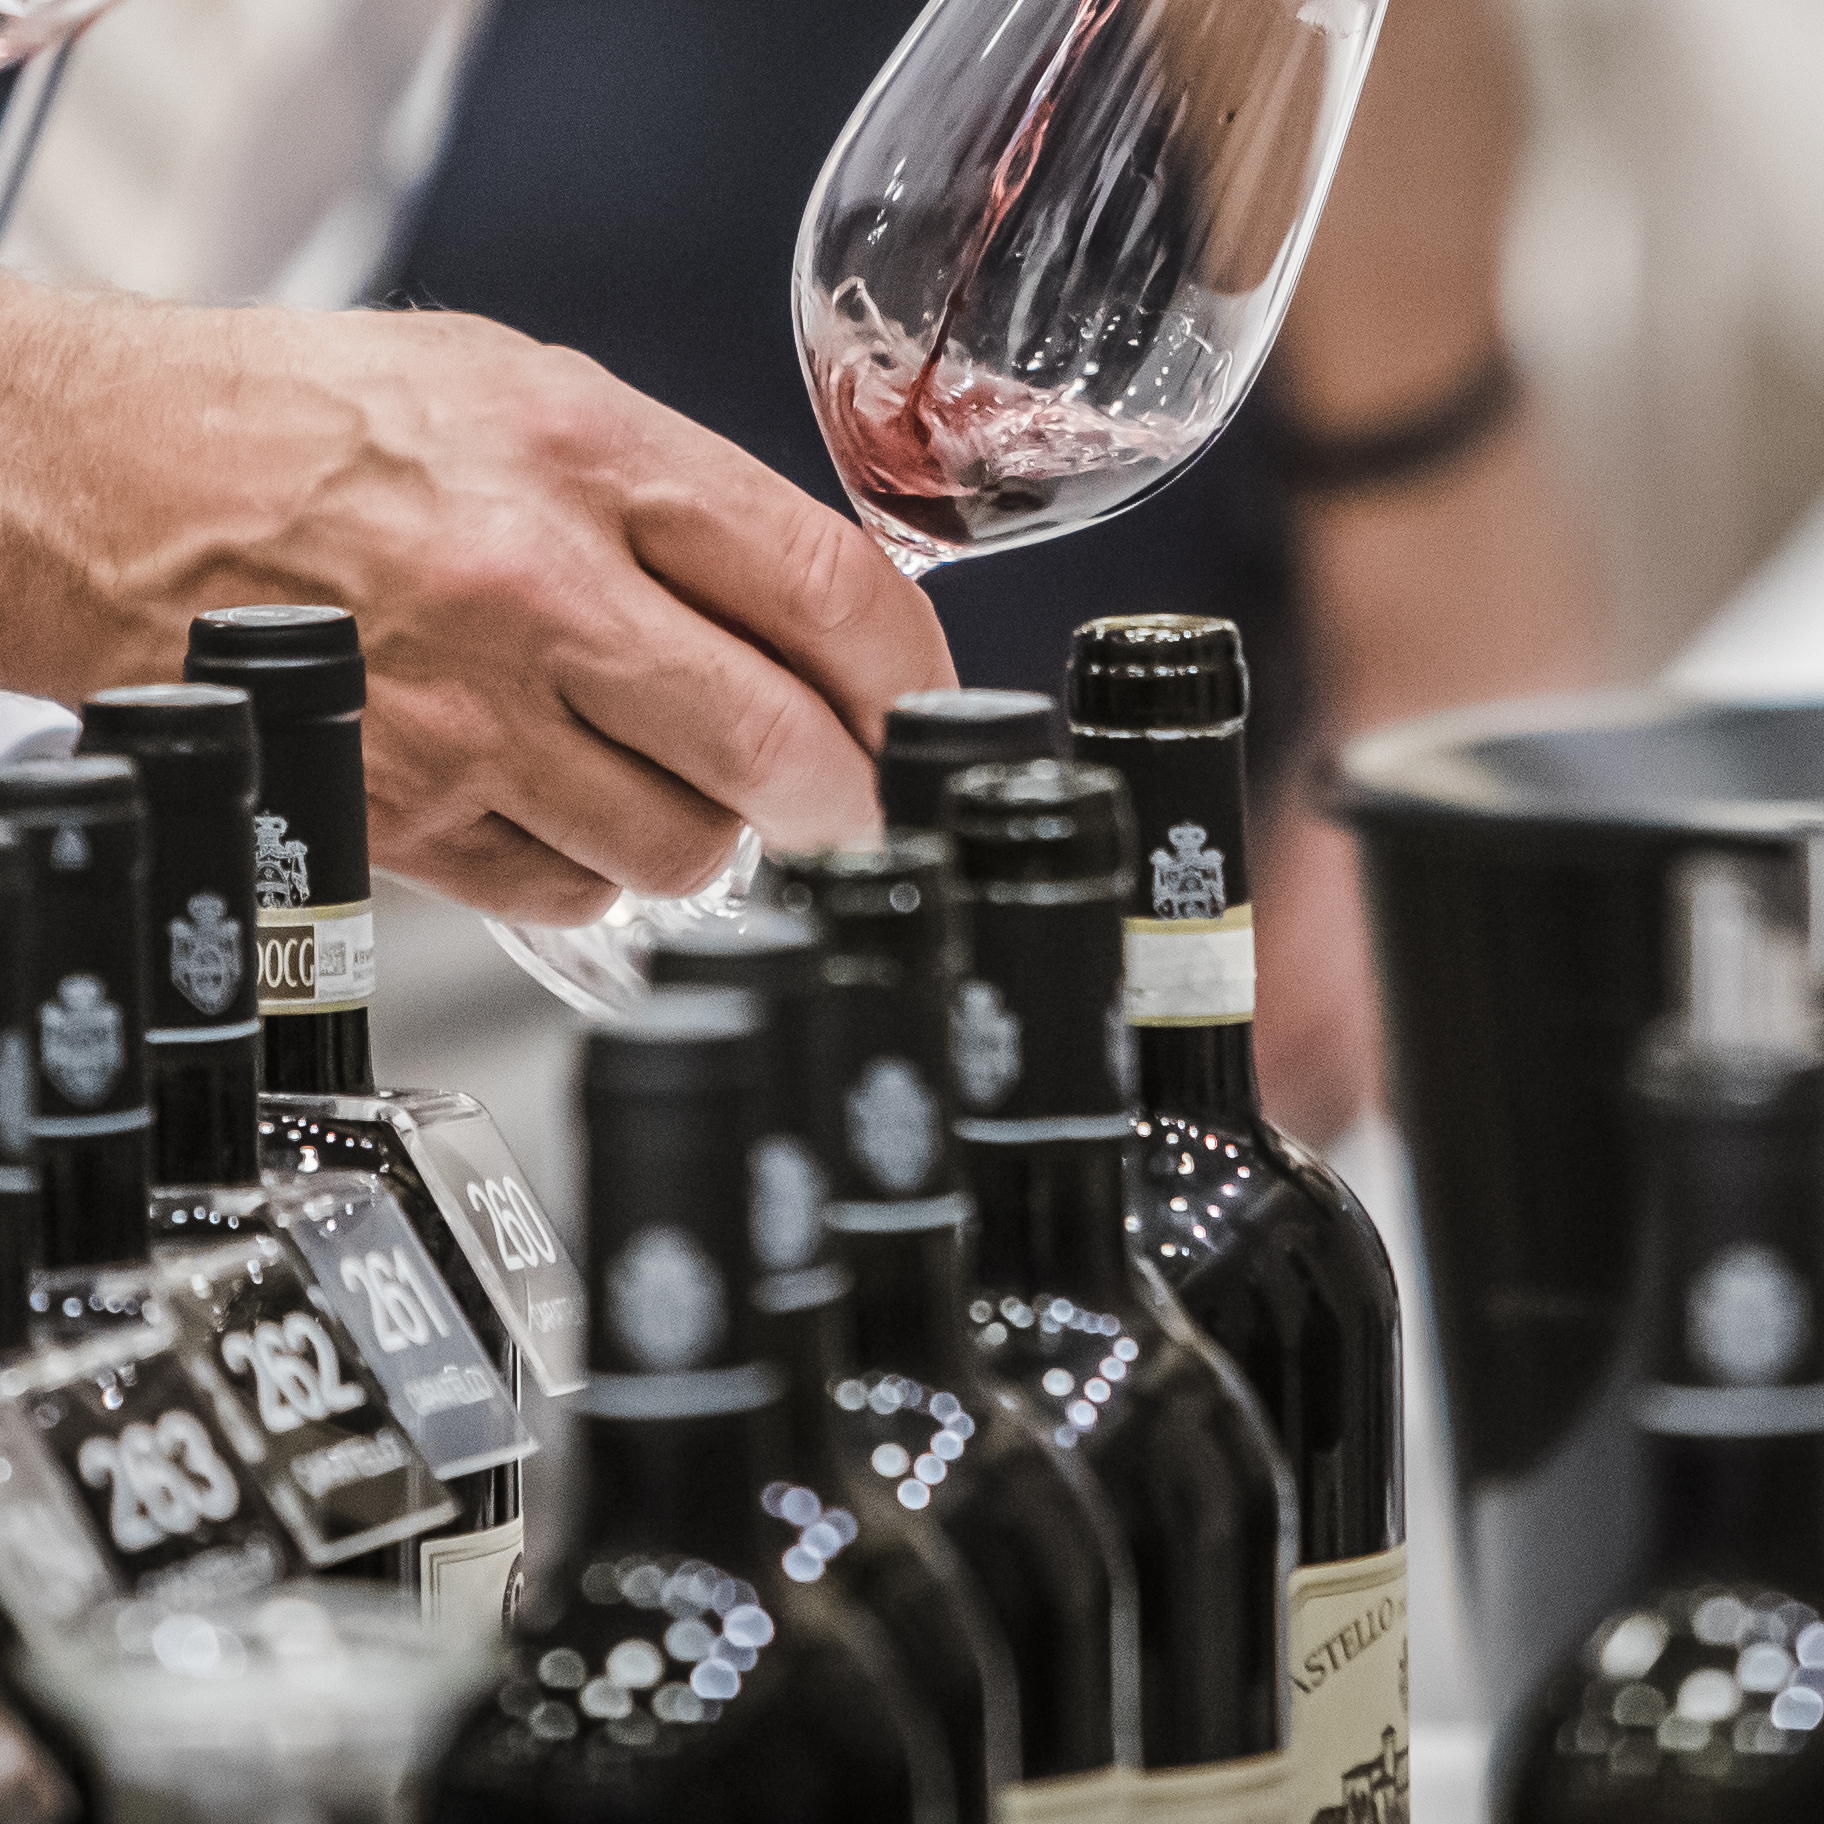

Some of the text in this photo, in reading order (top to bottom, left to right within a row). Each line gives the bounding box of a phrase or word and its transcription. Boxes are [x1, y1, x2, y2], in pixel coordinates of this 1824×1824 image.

[465, 1175, 558, 1272] 260
[340, 1247, 452, 1355] 261
[220, 1311, 367, 1434] 262
